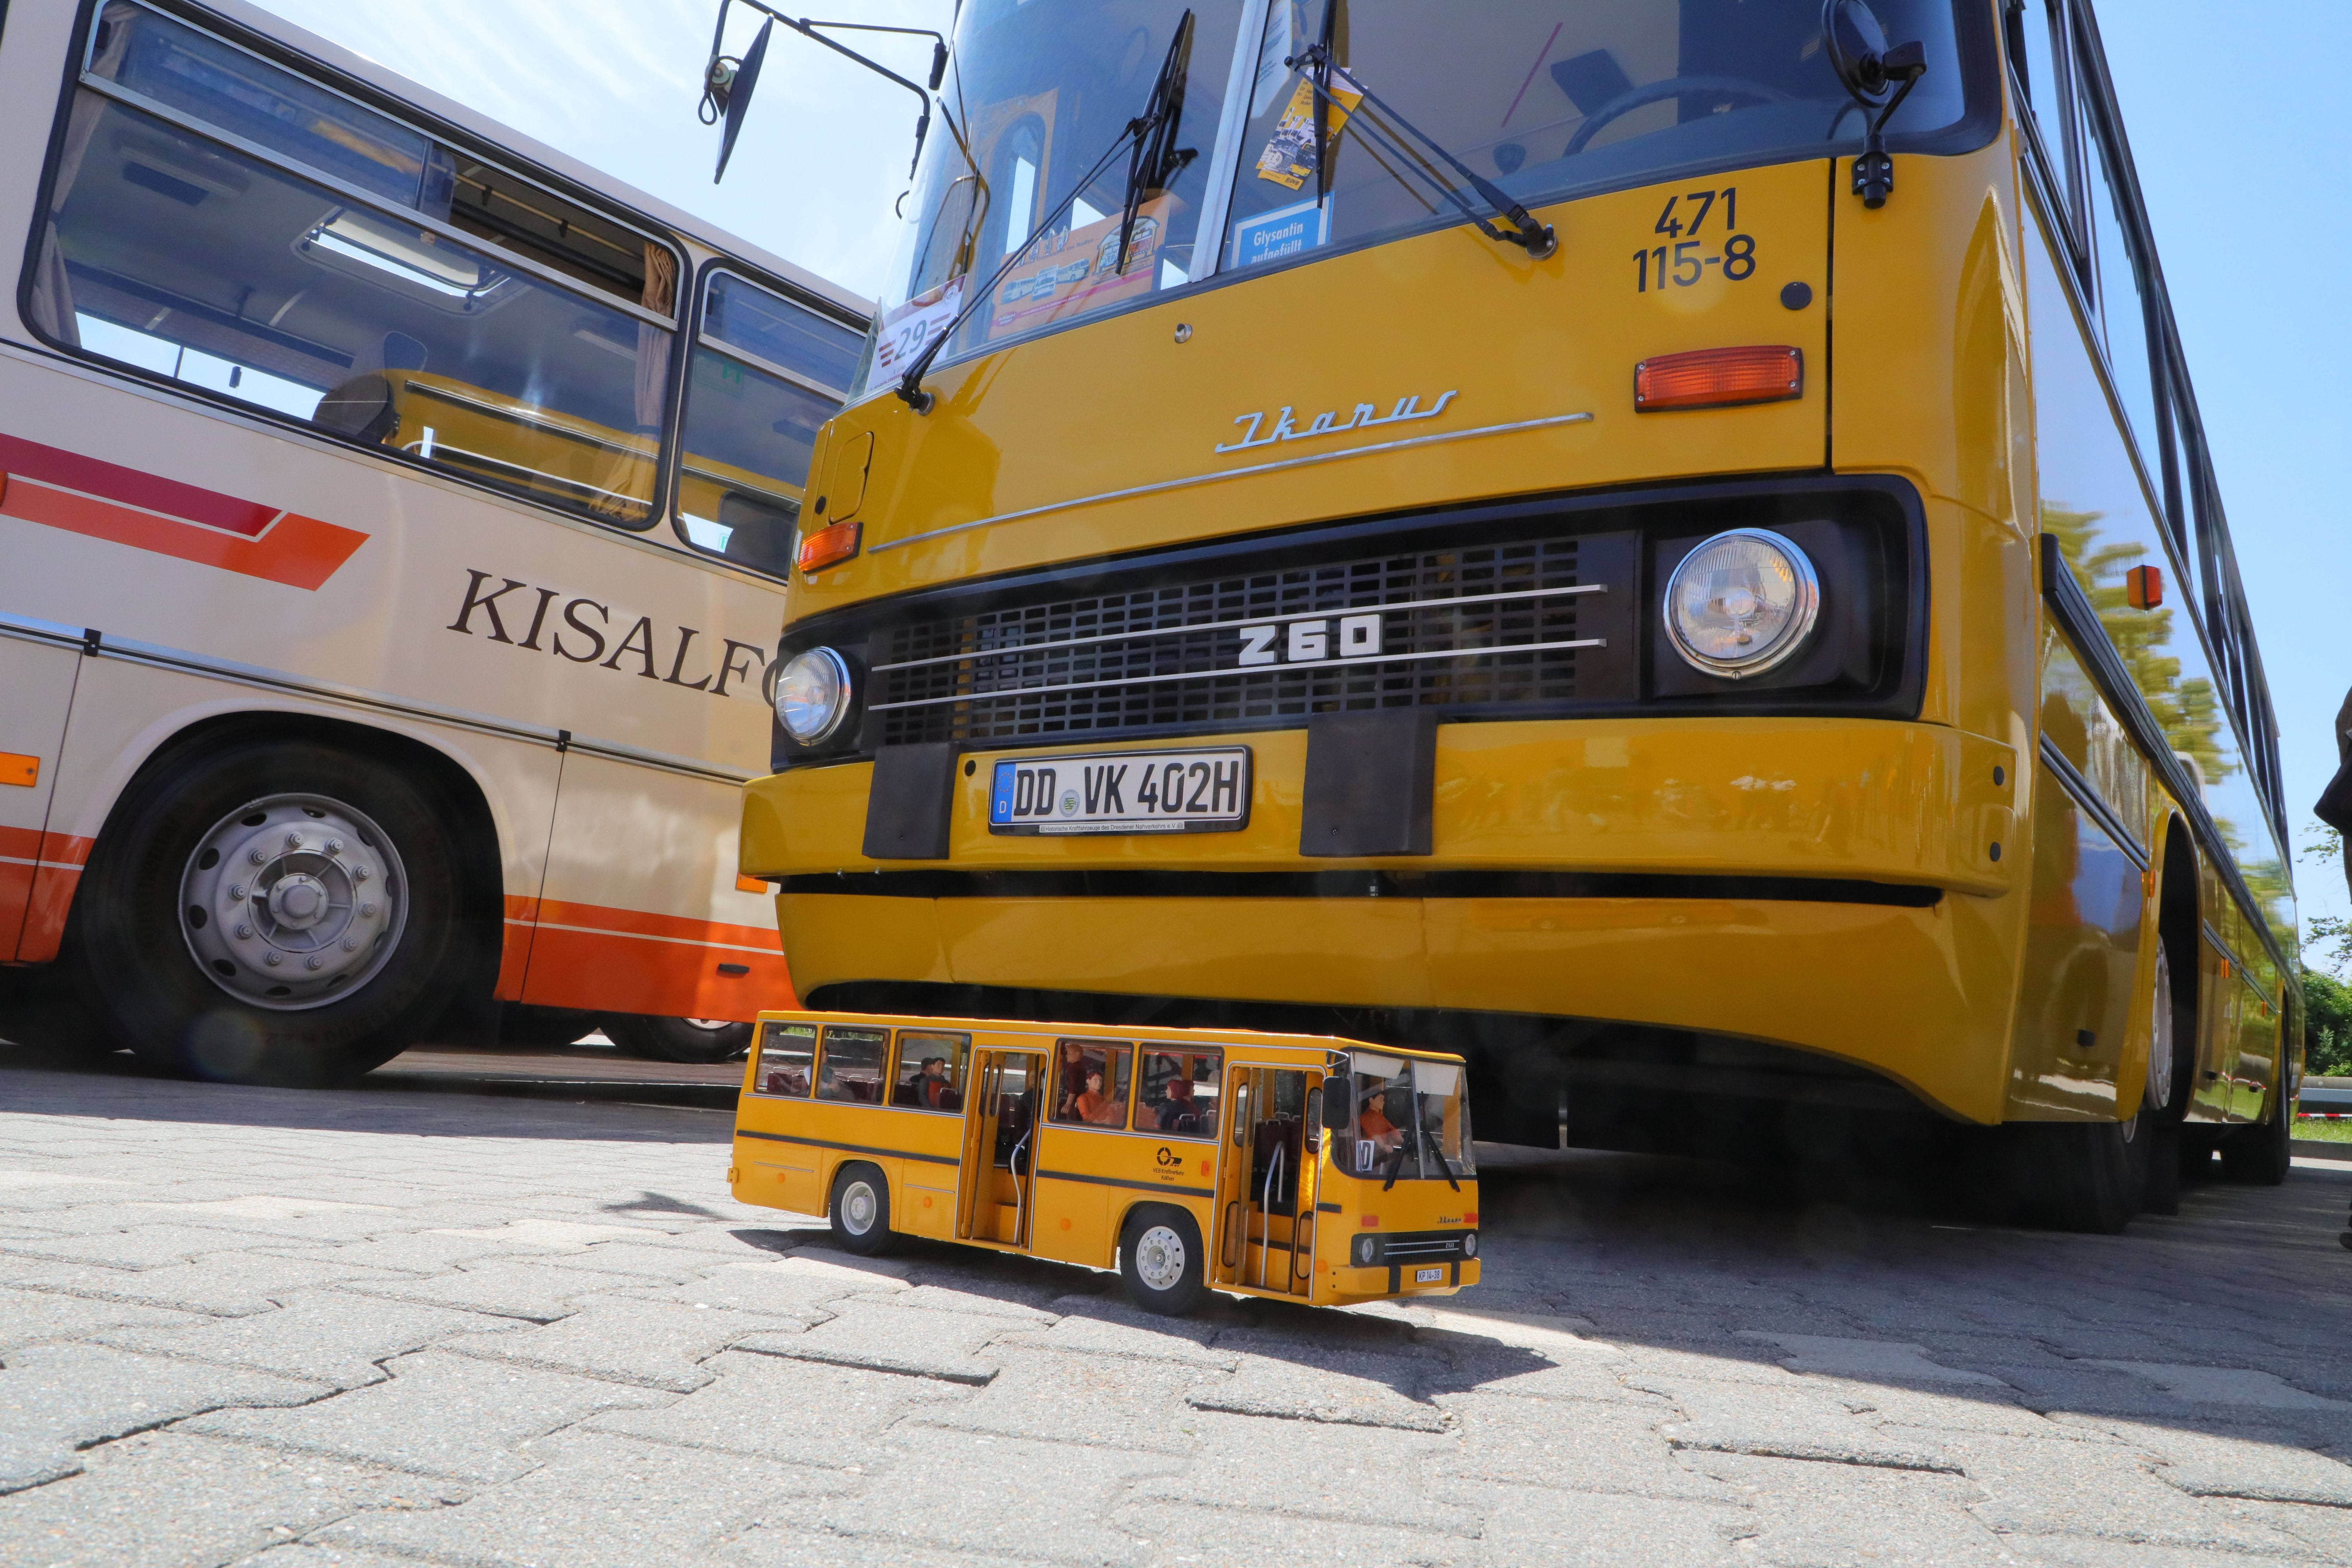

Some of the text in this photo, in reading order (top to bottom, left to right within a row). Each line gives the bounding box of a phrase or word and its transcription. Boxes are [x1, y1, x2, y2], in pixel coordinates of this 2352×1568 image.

[1254, 222, 1304, 247] Glysantin
[1655, 187, 1736, 239] 471
[1632, 234, 1756, 293] 115-8
[894, 319, 927, 361] 29
[1214, 390, 1458, 454] Ikarus
[1239, 613, 1382, 666] 260
[999, 800, 1006, 814] D
[1013, 768, 1056, 816] DD
[1084, 764, 1128, 814] VK
[1137, 760, 1239, 813] 402H
[1418, 1270, 1440, 1281] KP 14-38
